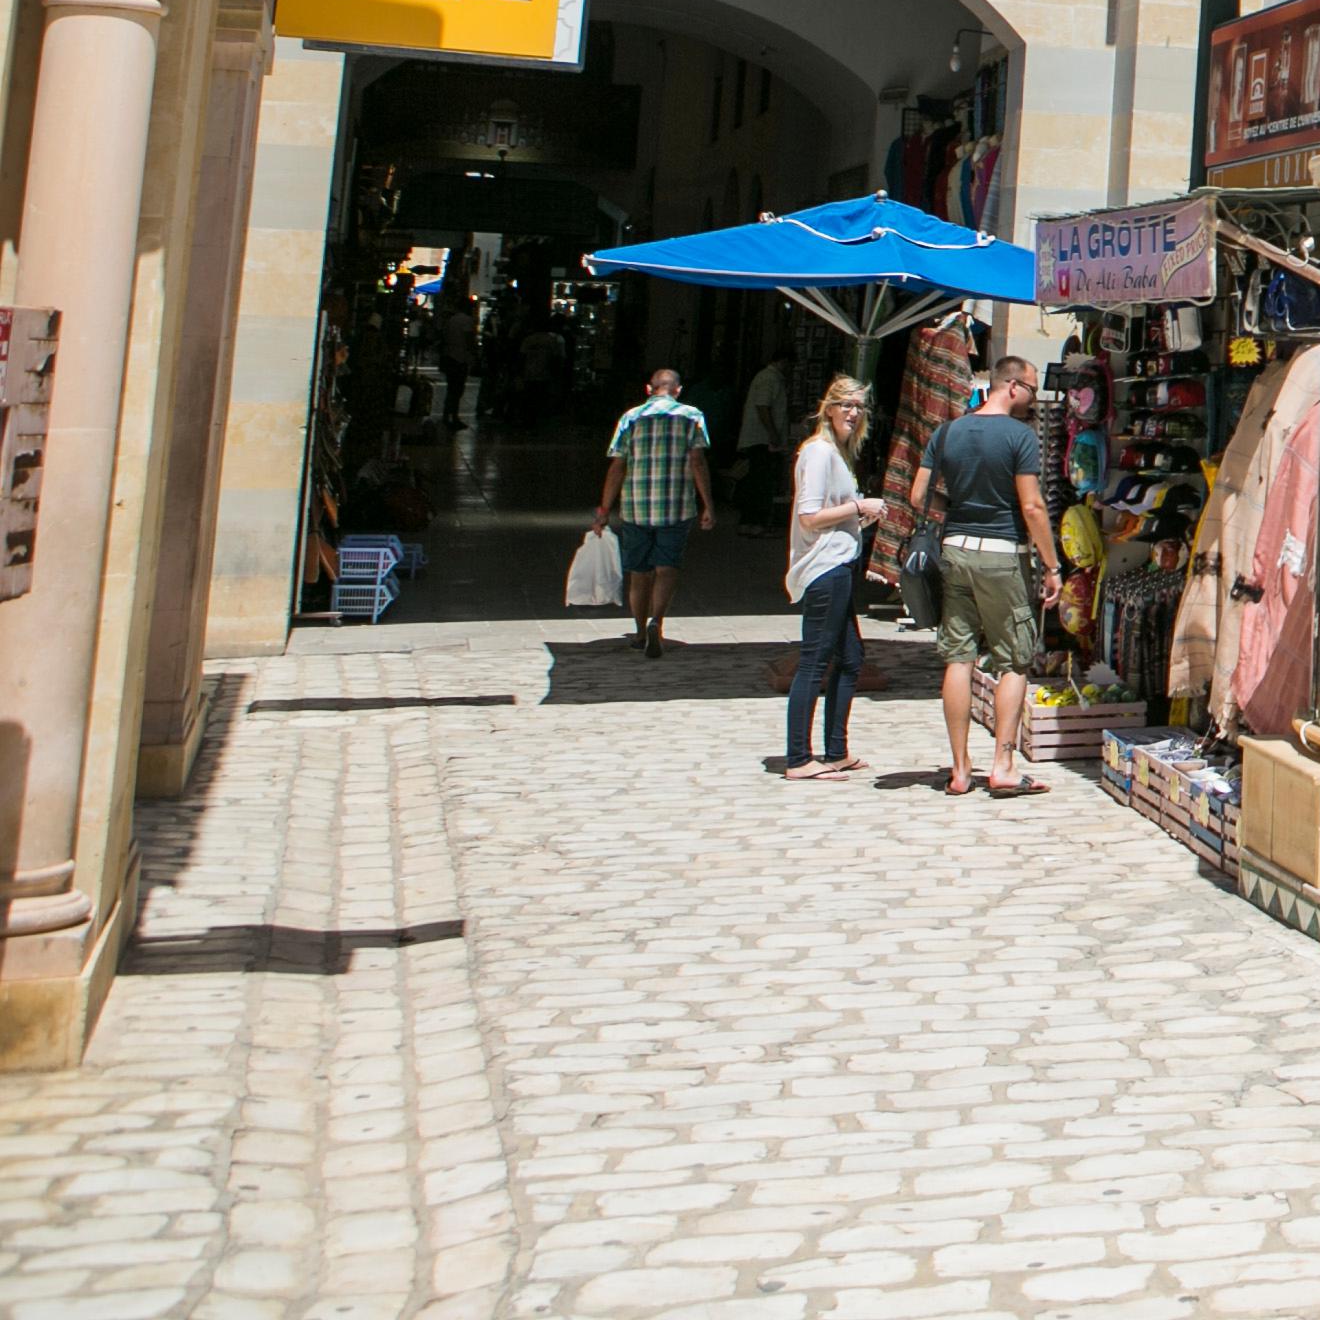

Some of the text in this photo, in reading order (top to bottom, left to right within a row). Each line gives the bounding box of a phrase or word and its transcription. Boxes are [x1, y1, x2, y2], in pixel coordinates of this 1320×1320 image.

[1264, 150, 1316, 186] LOOXI
[1058, 214, 1177, 262] LA GROTTE
[1163, 245, 1185, 276] FIXED
[1096, 271, 1116, 291] Ali
[1123, 264, 1158, 290] Baba
